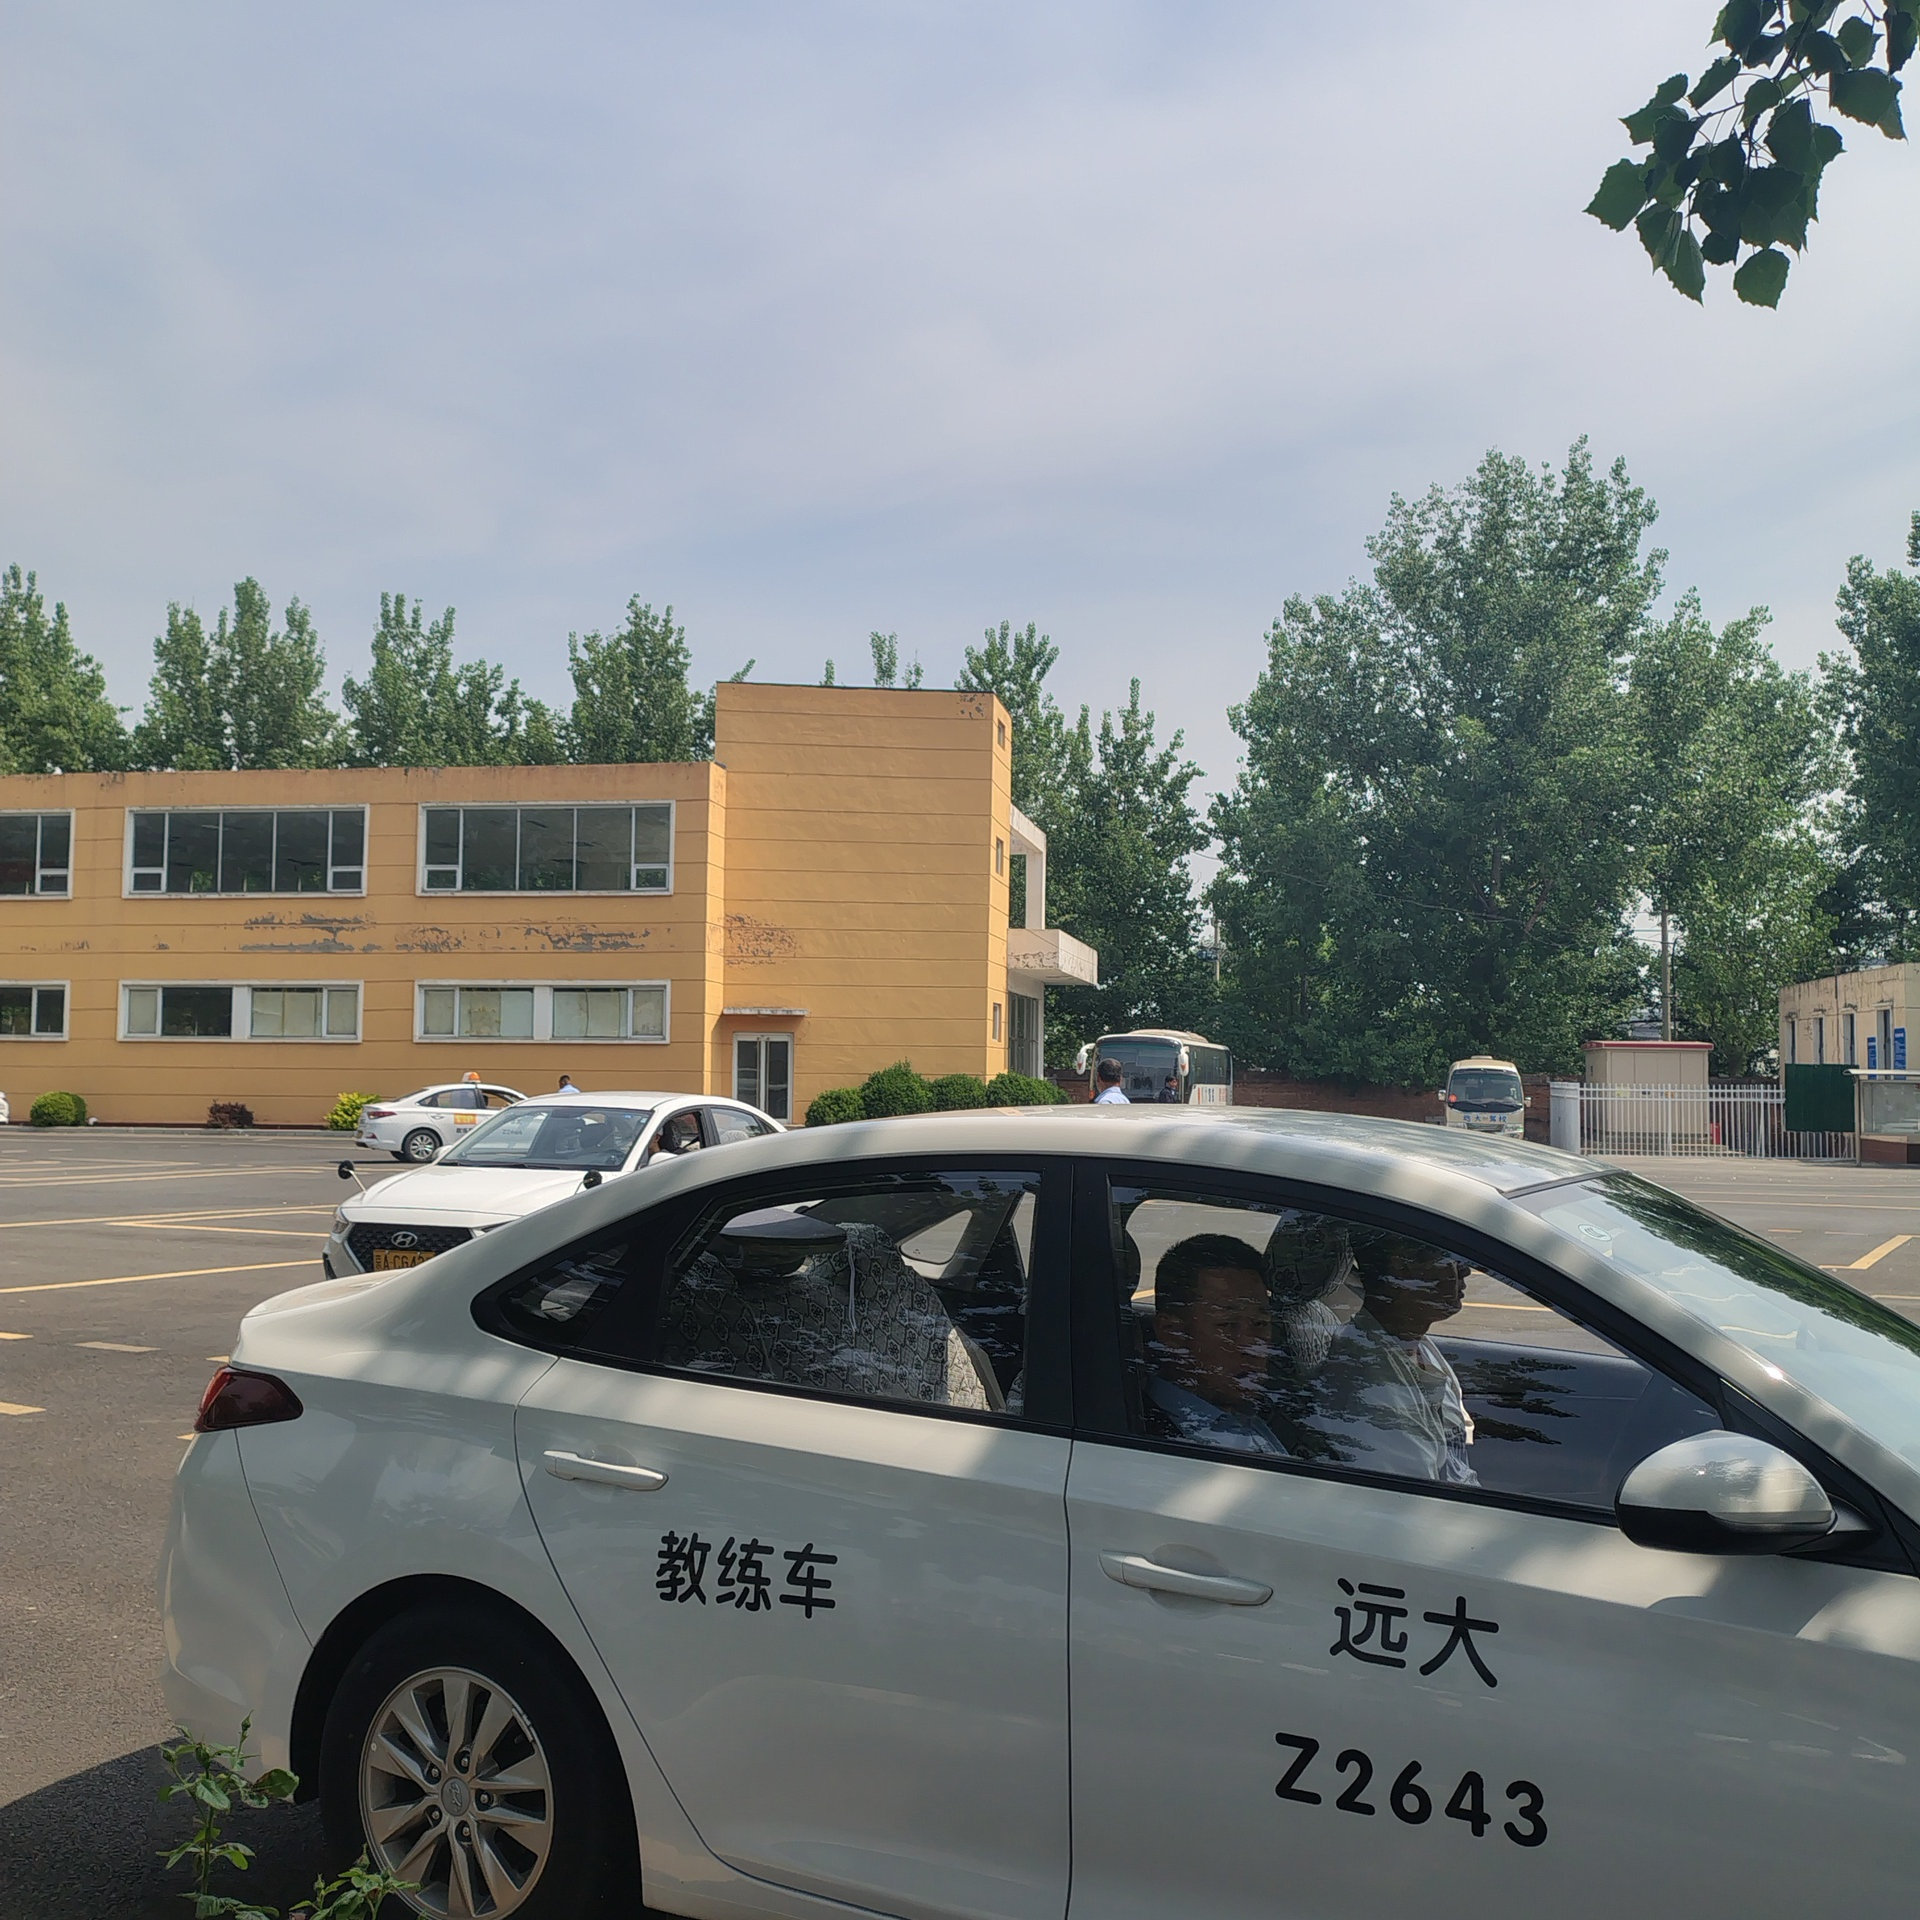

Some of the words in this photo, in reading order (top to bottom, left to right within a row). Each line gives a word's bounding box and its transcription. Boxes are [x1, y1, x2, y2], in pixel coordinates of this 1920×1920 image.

[655, 1530, 838, 1619] 教练车
[1329, 1577, 1499, 1688] 远大
[1275, 1732, 1548, 1847] Z2643
